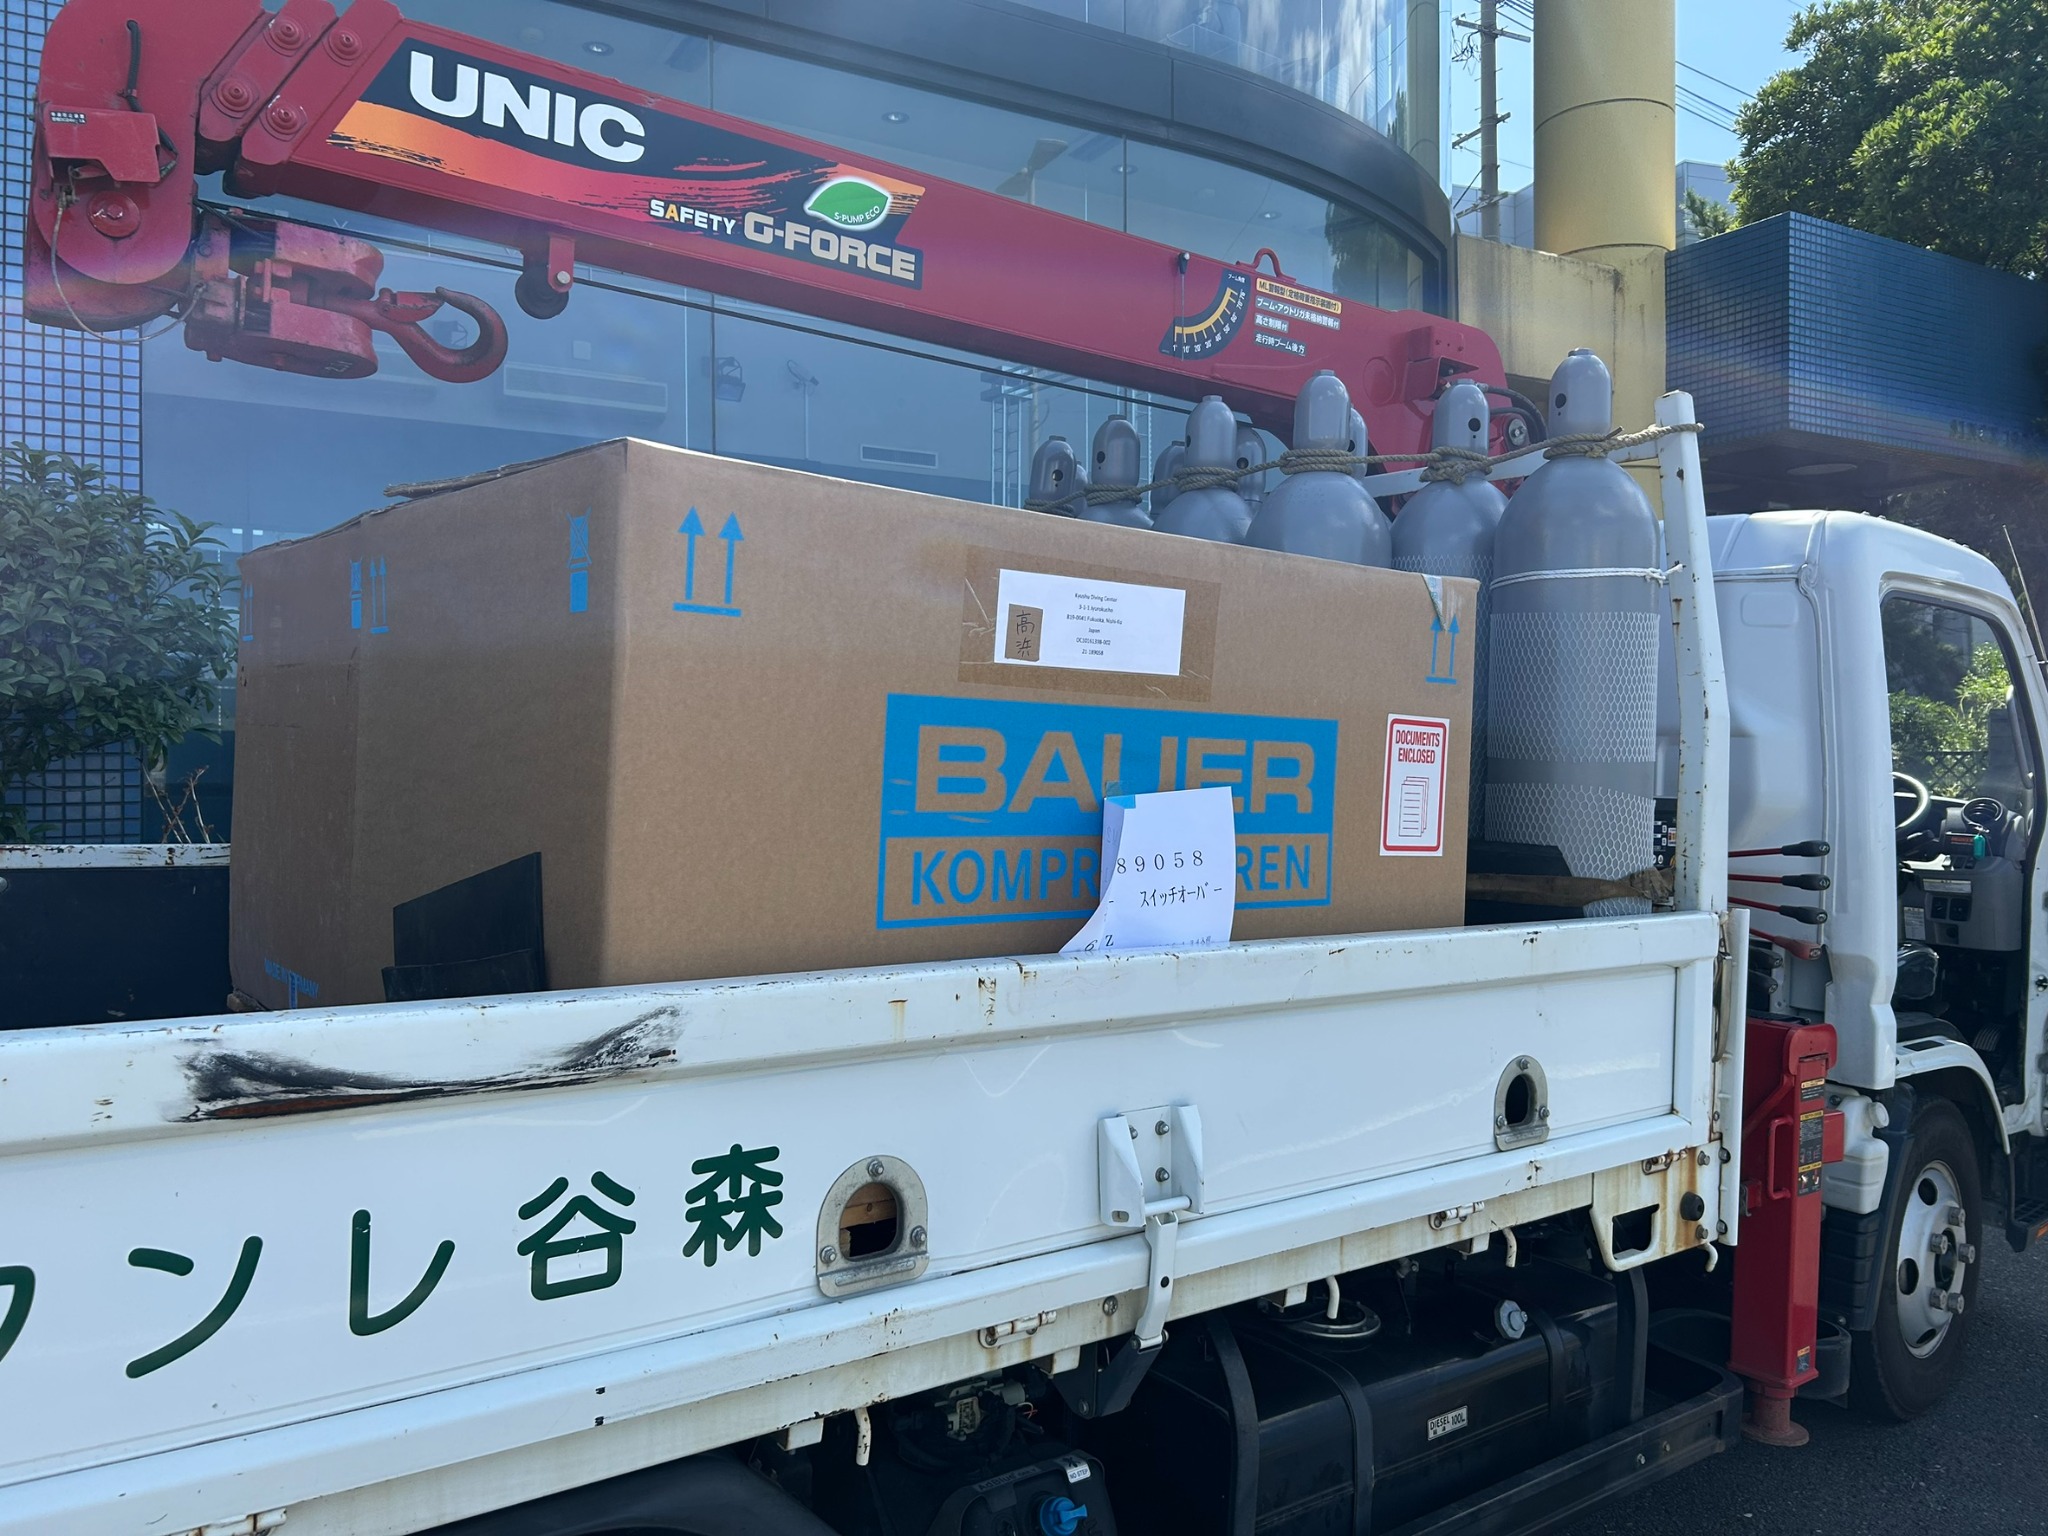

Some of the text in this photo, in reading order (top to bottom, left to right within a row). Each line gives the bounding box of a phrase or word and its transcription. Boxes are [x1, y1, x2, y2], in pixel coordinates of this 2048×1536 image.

[409, 50, 646, 165] UNIC
[865, 205, 880, 221] ECO
[649, 198, 916, 282] SAFETY G-FORCE
[1395, 729, 1440, 747] DOCUMENTS
[1397, 748, 1436, 764] ENCLOSED
[915, 725, 1316, 815] BAUER
[911, 843, 1311, 907] KOMPRREN
[1429, 1415, 1450, 1431] DIESEL
